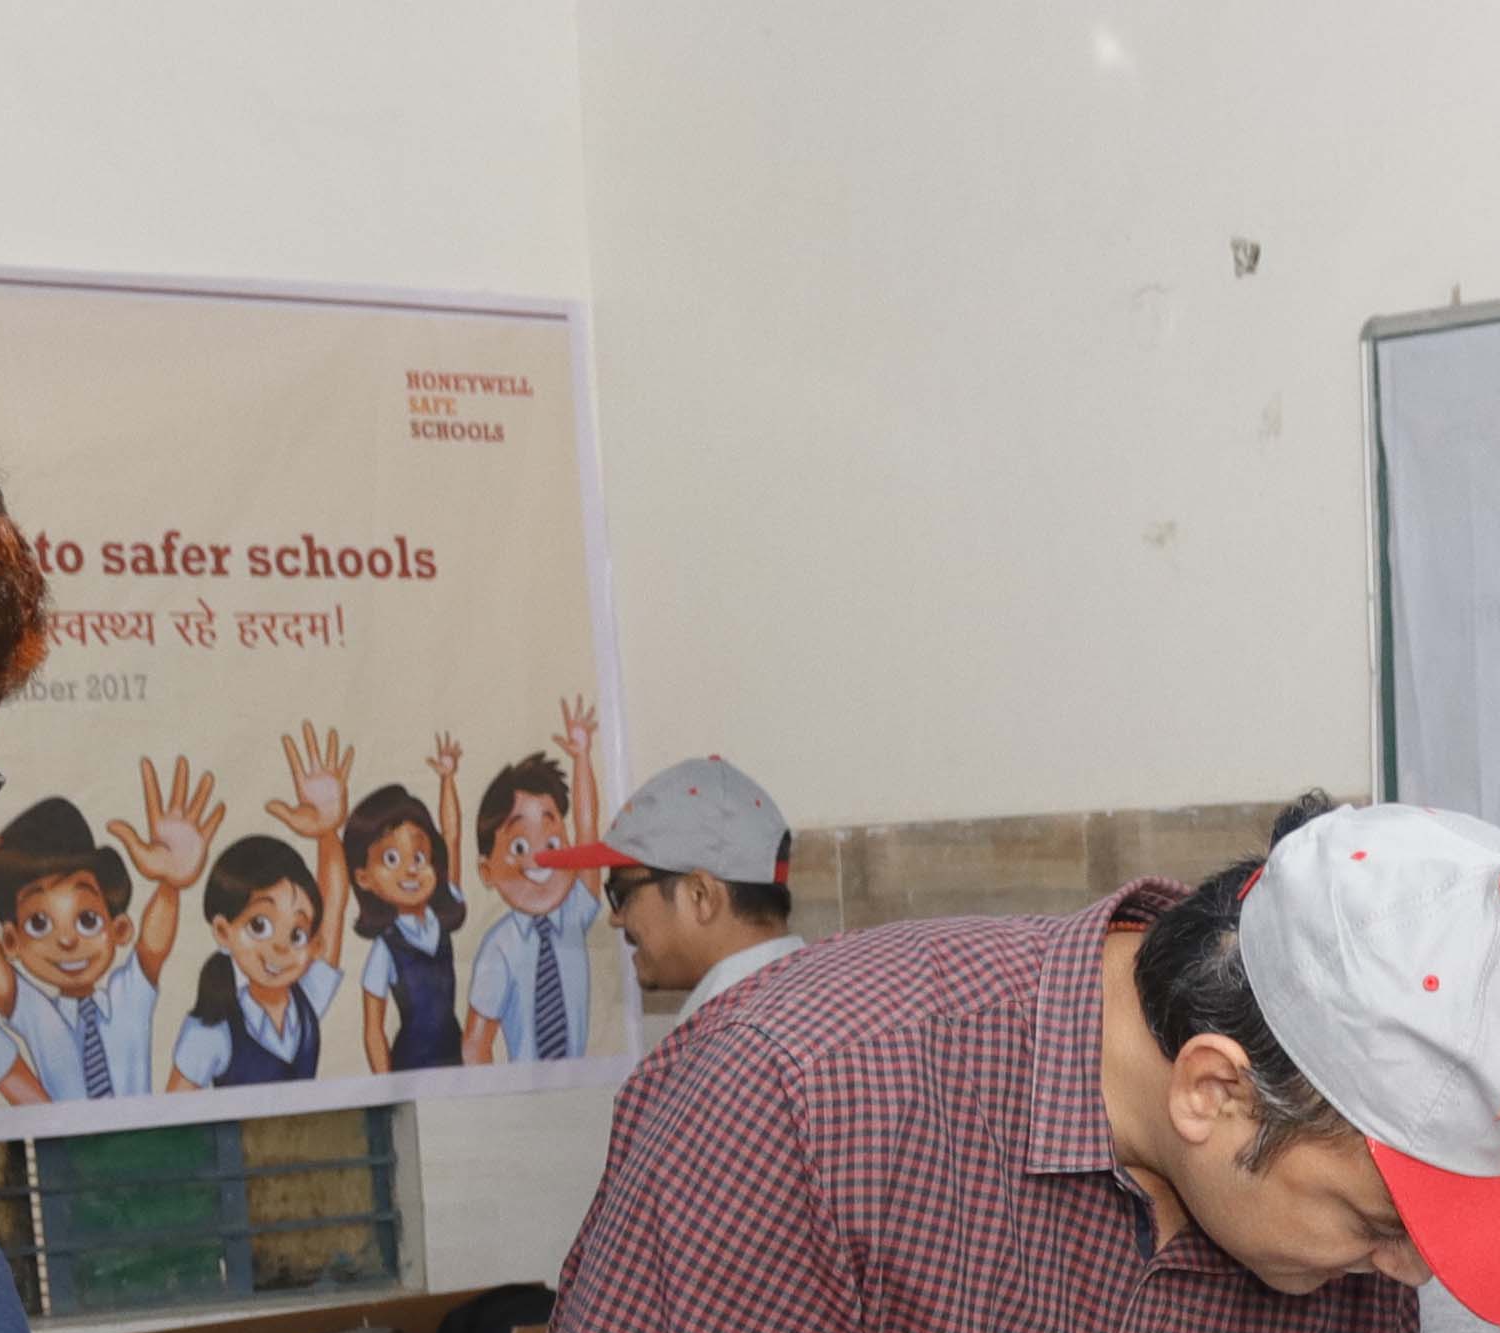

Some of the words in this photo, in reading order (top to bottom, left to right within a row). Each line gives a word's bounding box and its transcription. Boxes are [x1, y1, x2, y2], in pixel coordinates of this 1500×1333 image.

[406, 370, 534, 397] HONEYWELL
[409, 396, 457, 415] SAFE
[410, 420, 506, 443] SCHOOLS
[34, 531, 84, 576] to
[102, 531, 231, 576] safer
[247, 534, 439, 579] schools
[170, 597, 218, 648] रहे
[234, 603, 347, 648] हरदम!
[86, 673, 148, 700] 2017
